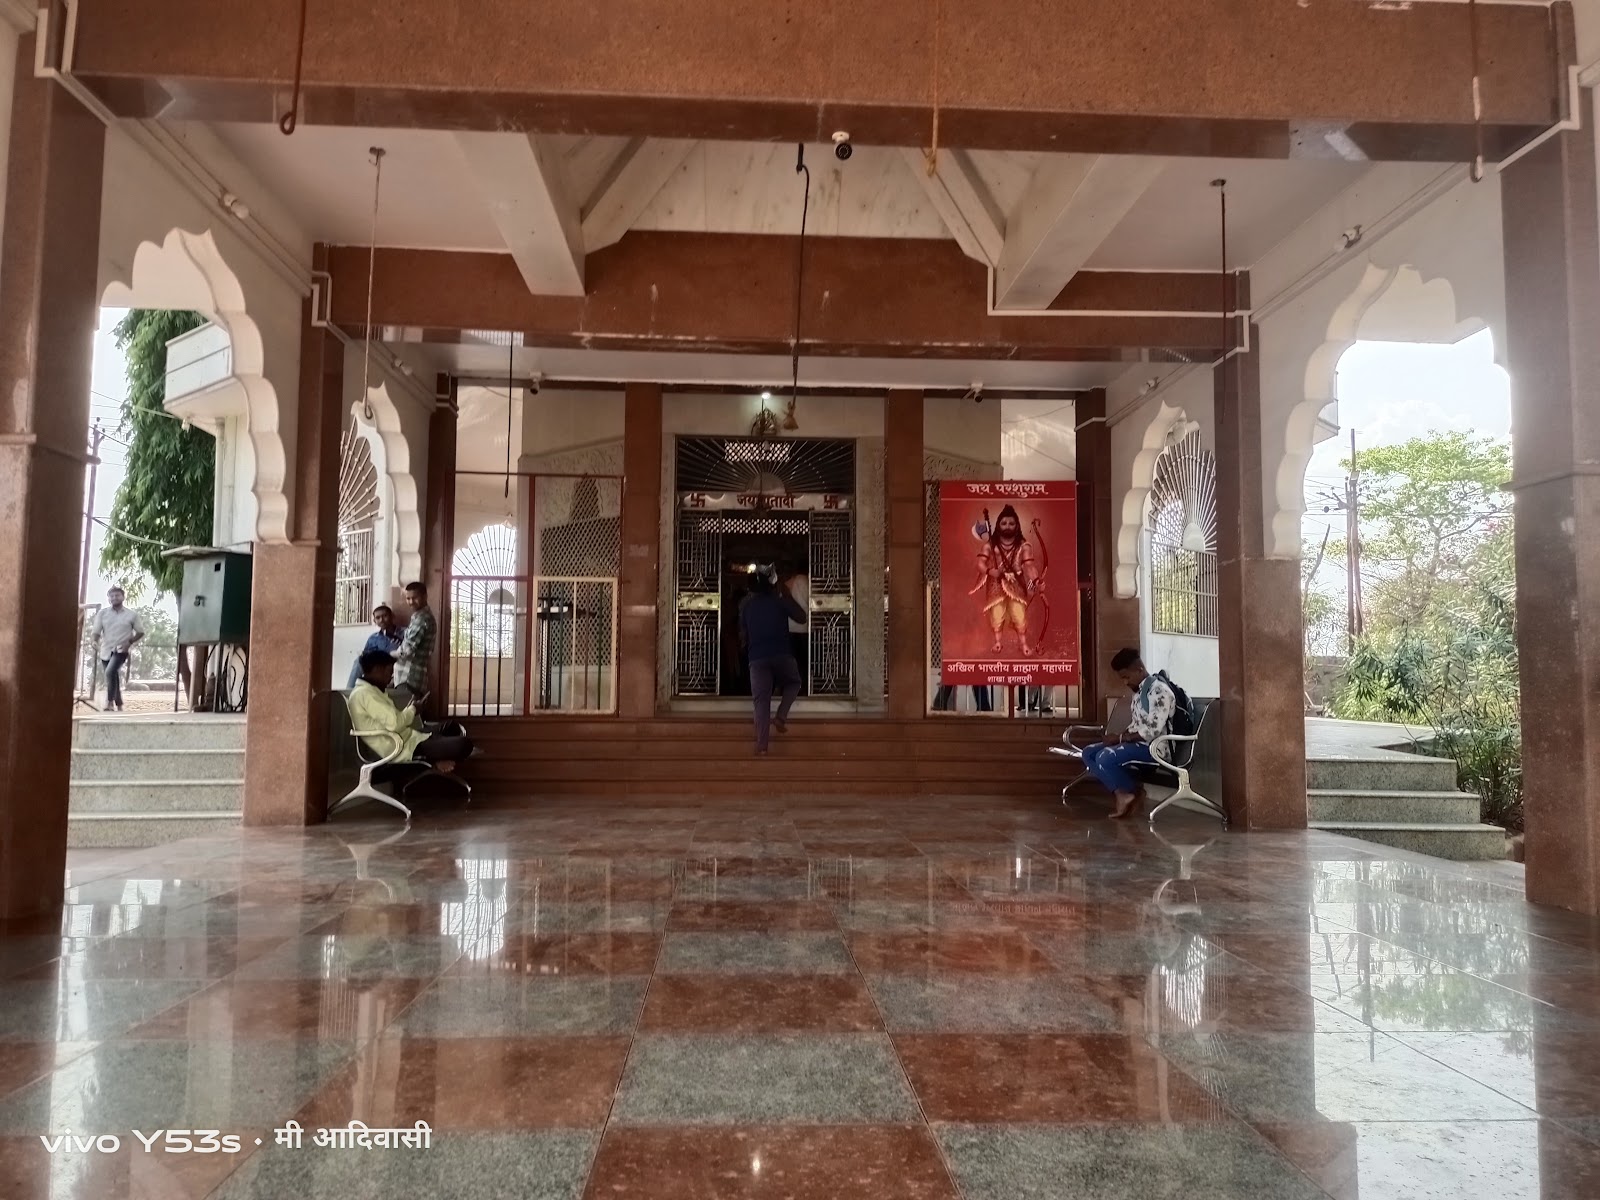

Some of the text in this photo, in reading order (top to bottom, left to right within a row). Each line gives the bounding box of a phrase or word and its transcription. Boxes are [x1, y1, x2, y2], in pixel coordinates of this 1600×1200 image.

[966, 483, 1049, 498] जय परशुराम
[947, 661, 975, 673] अखिल
[978, 661, 1009, 673] भारतीय
[1042, 661, 1072, 674] महासंघ
[987, 674, 1032, 685] शाखा इगतपुरी
